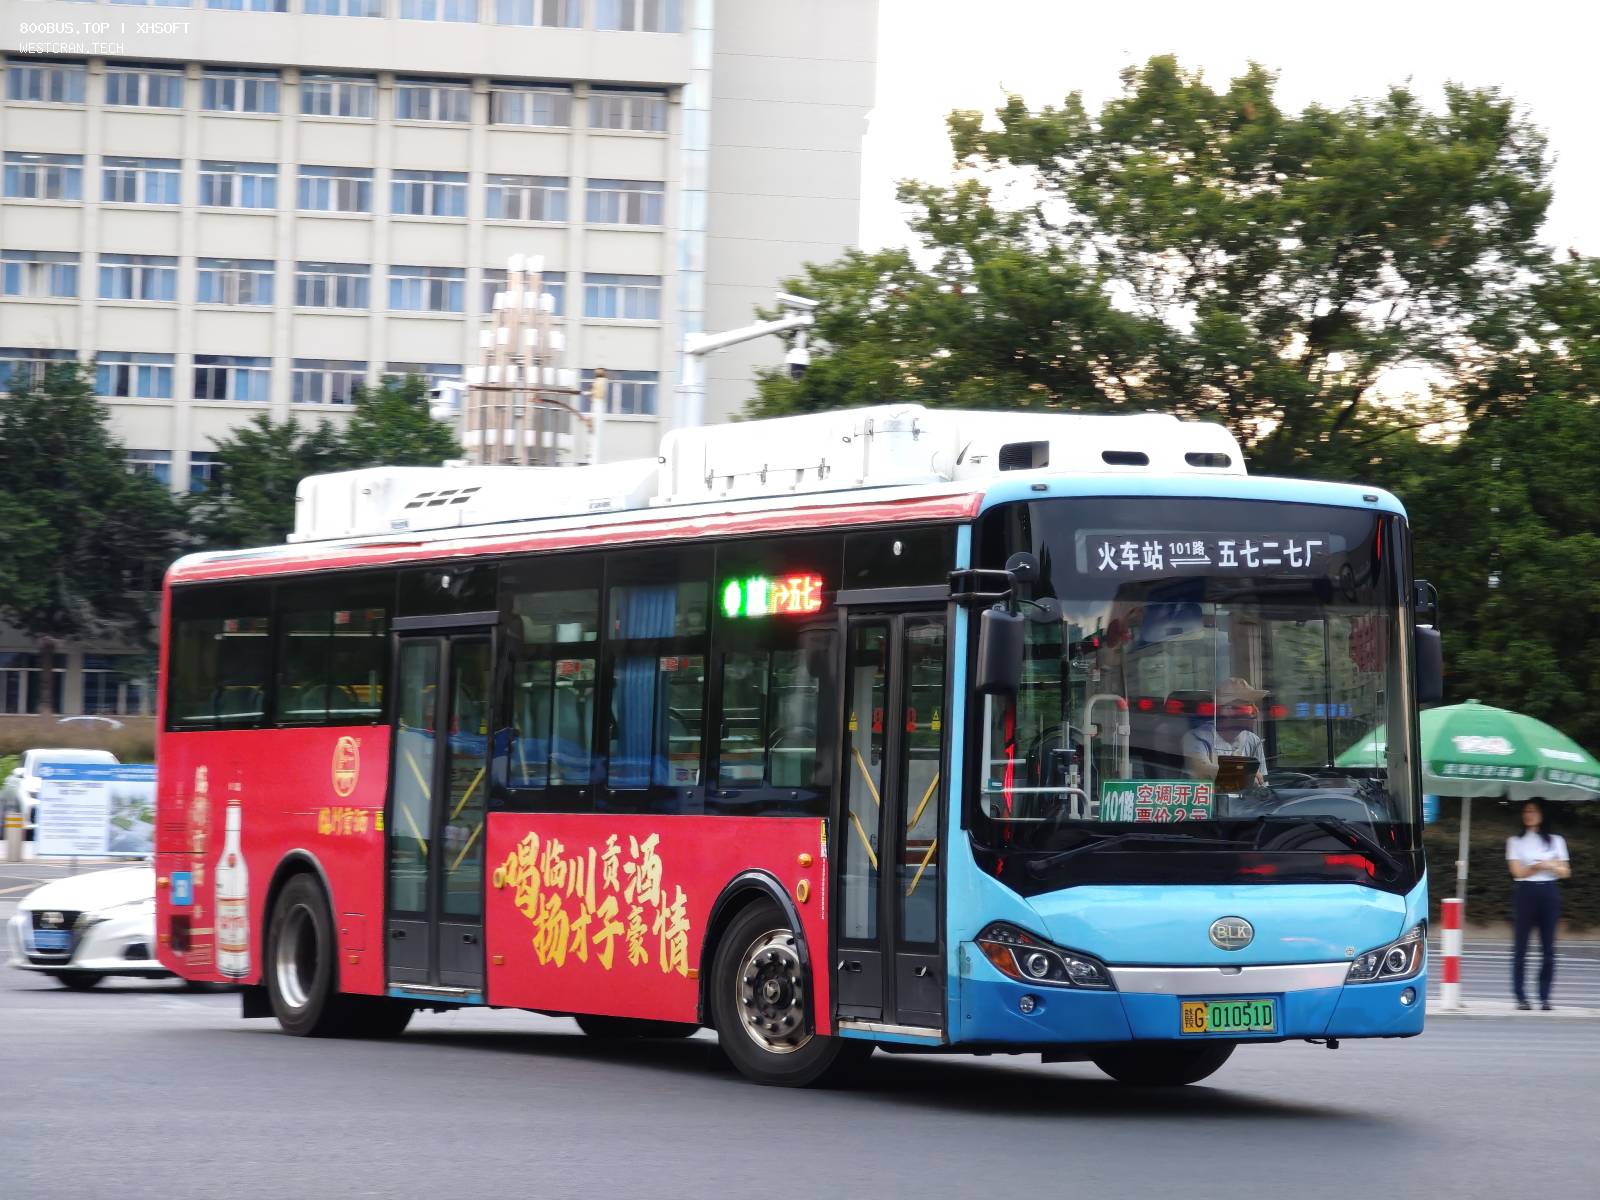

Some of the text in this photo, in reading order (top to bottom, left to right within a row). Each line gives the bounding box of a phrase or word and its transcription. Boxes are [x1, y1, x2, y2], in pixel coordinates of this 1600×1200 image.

[1098, 539, 1323, 571] 火车站 101路 五七二七厂
[1136, 784, 1210, 805] 空调开启
[502, 831, 663, 919] 喝临川贡酒
[532, 885, 690, 977] 扬才子豪情
[1216, 925, 1248, 938] BLK
